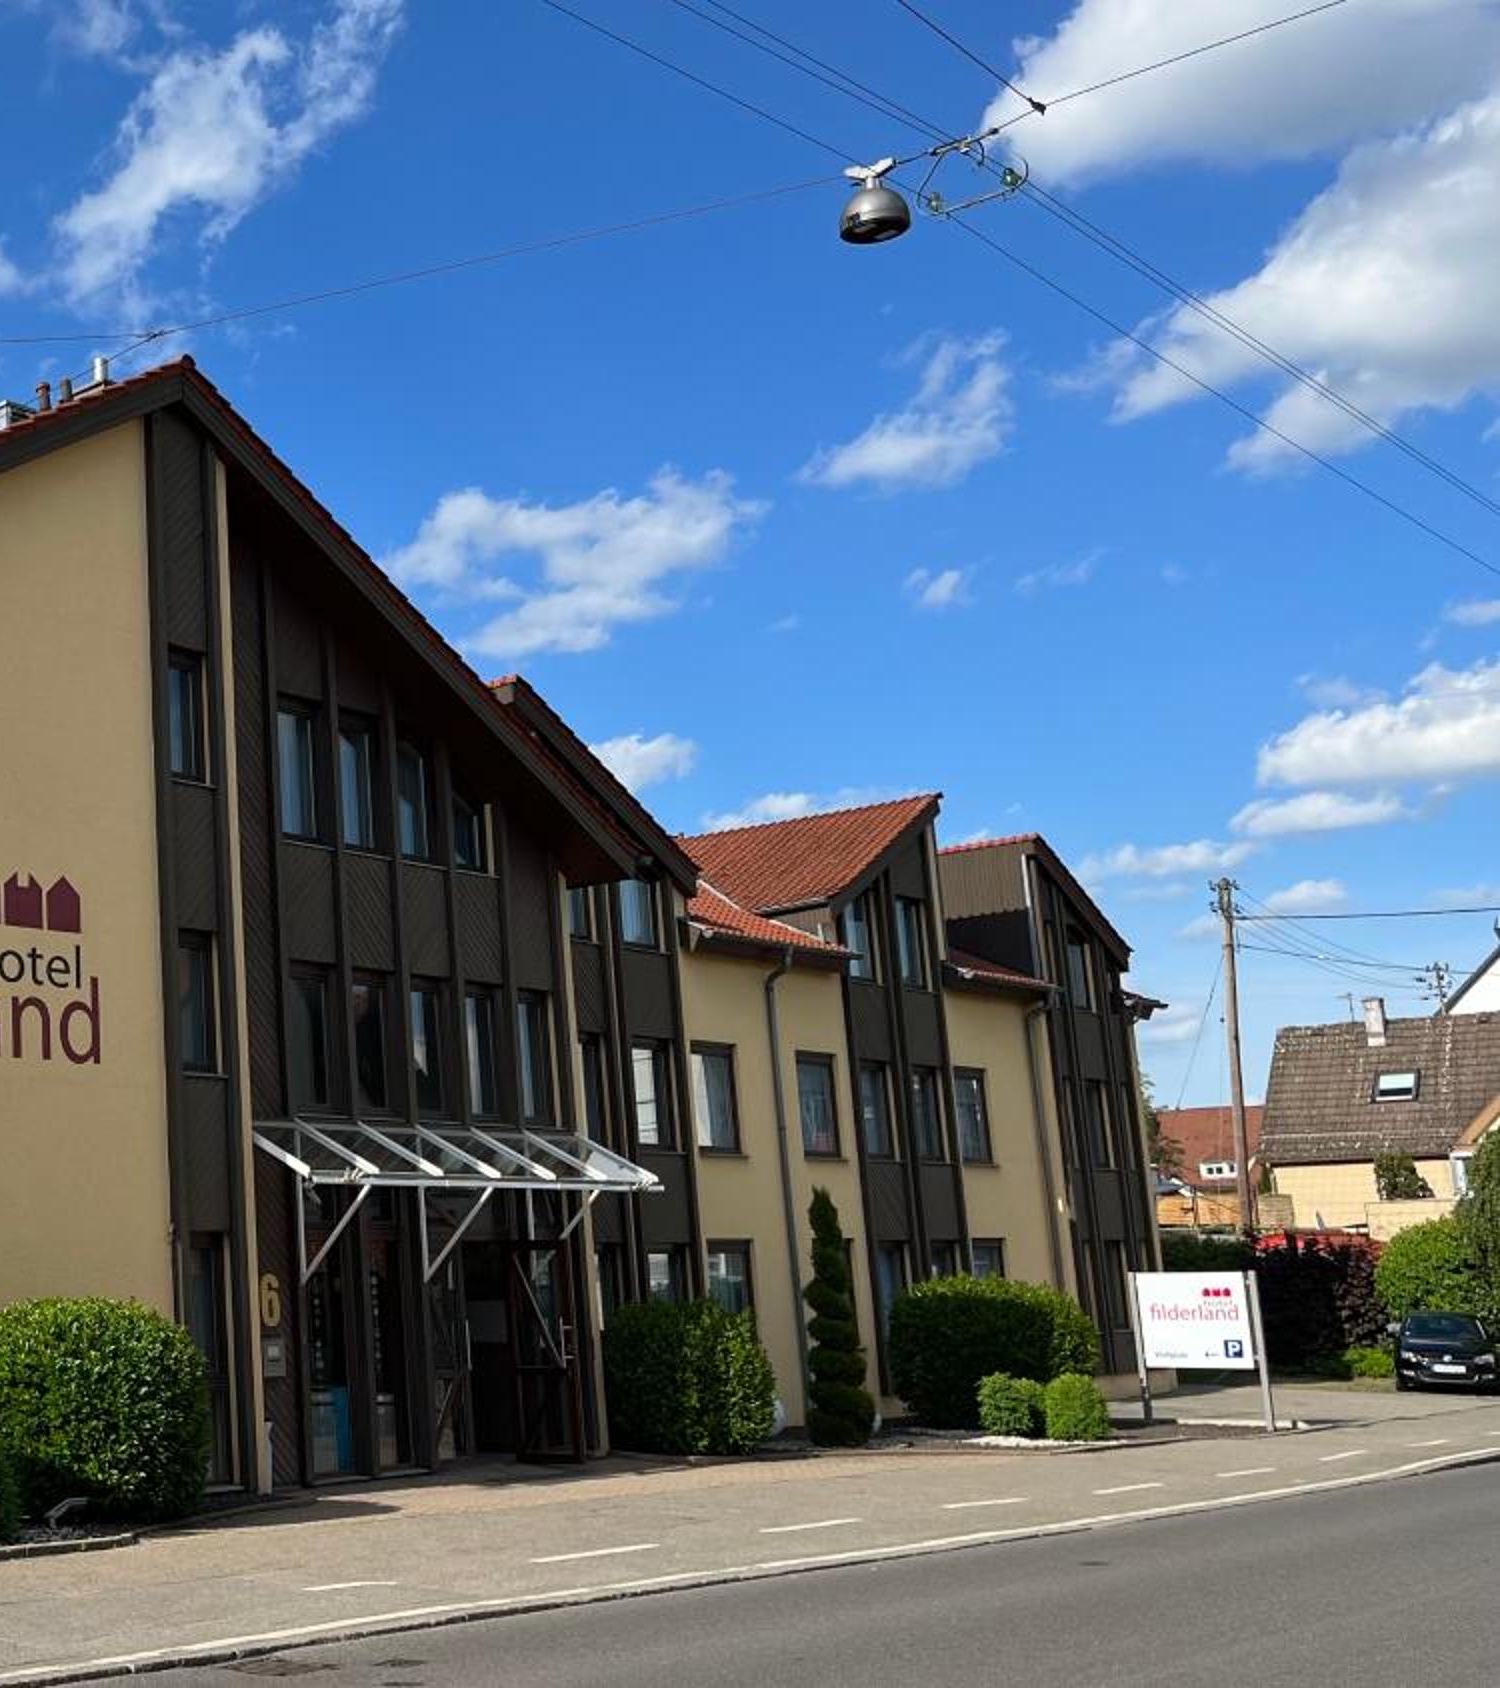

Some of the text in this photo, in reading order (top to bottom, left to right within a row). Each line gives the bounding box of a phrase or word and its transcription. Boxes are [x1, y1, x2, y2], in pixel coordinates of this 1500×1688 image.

[260, 1273, 281, 1327] 6
[1150, 1303, 1239, 1320] filderland
[1227, 1341, 1240, 1357] P
